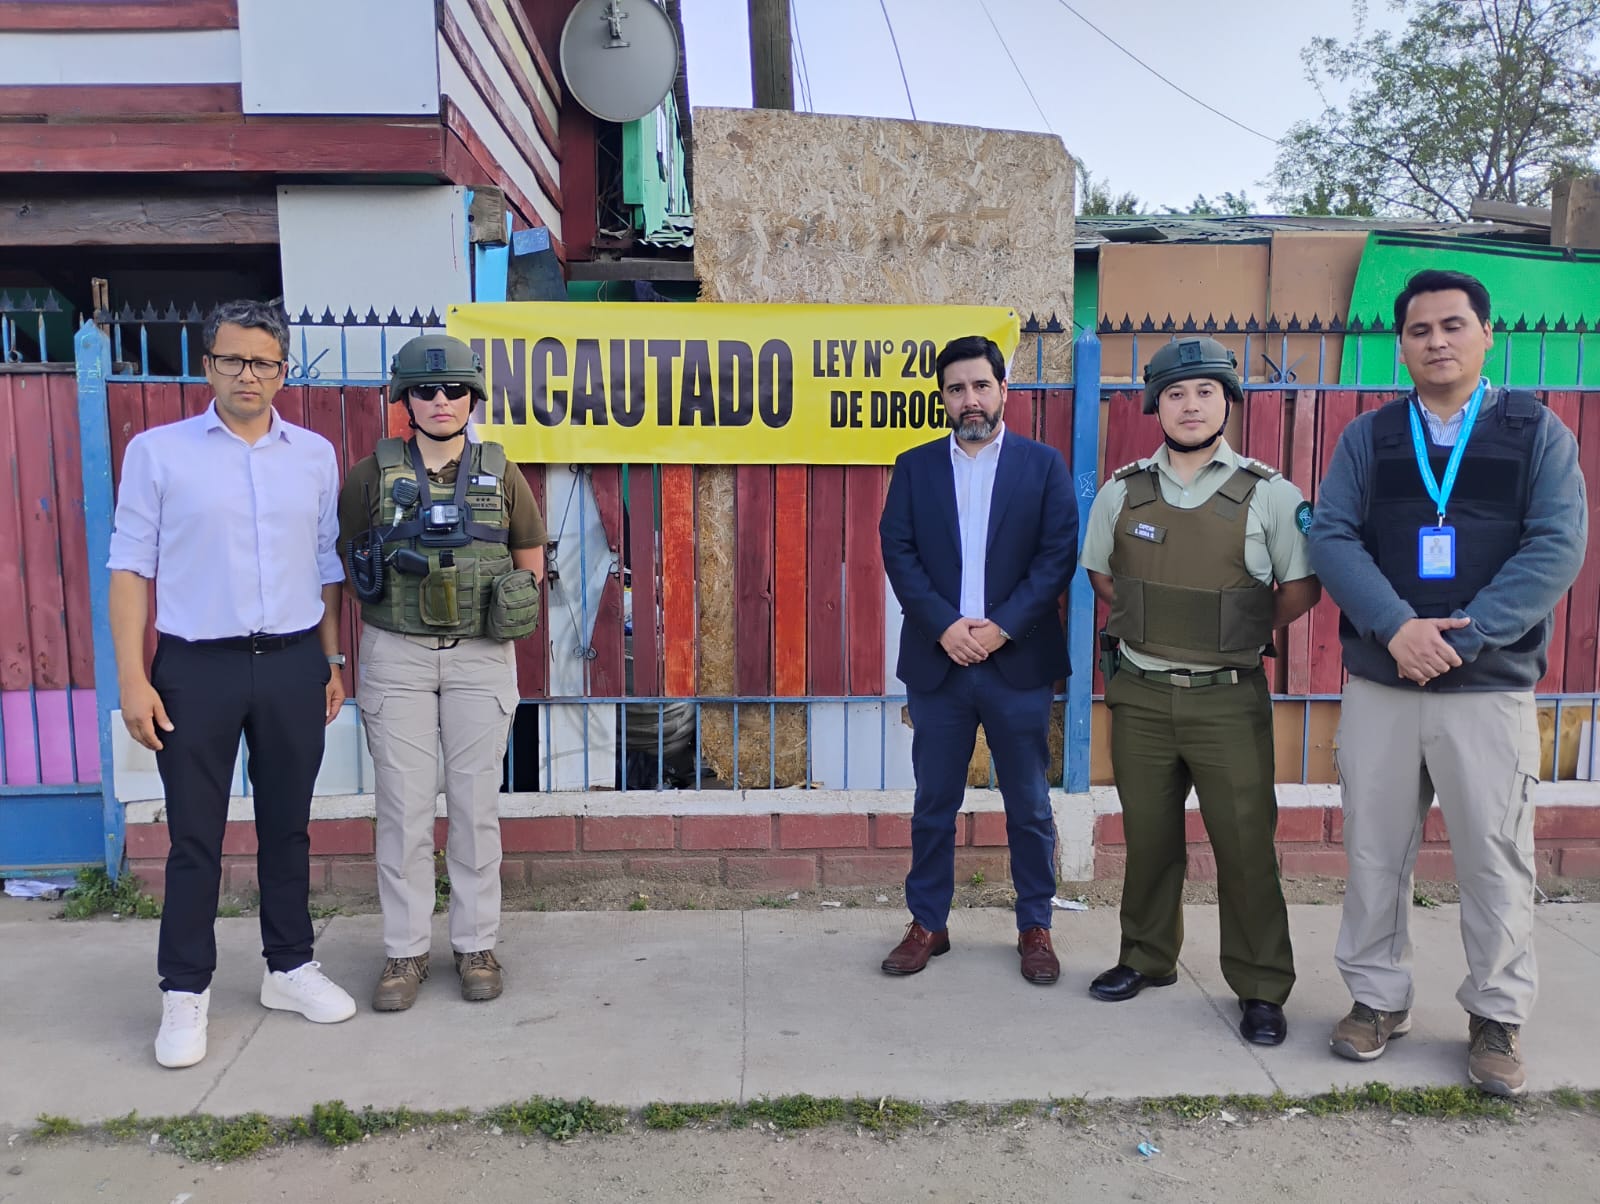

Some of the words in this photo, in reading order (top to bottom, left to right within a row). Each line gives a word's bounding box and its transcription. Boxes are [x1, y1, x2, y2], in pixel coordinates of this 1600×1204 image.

[813, 340, 857, 378] LEY
[470, 337, 793, 428] INCAUTADO
[830, 391, 863, 429] DE
[870, 391, 953, 429] DROG
